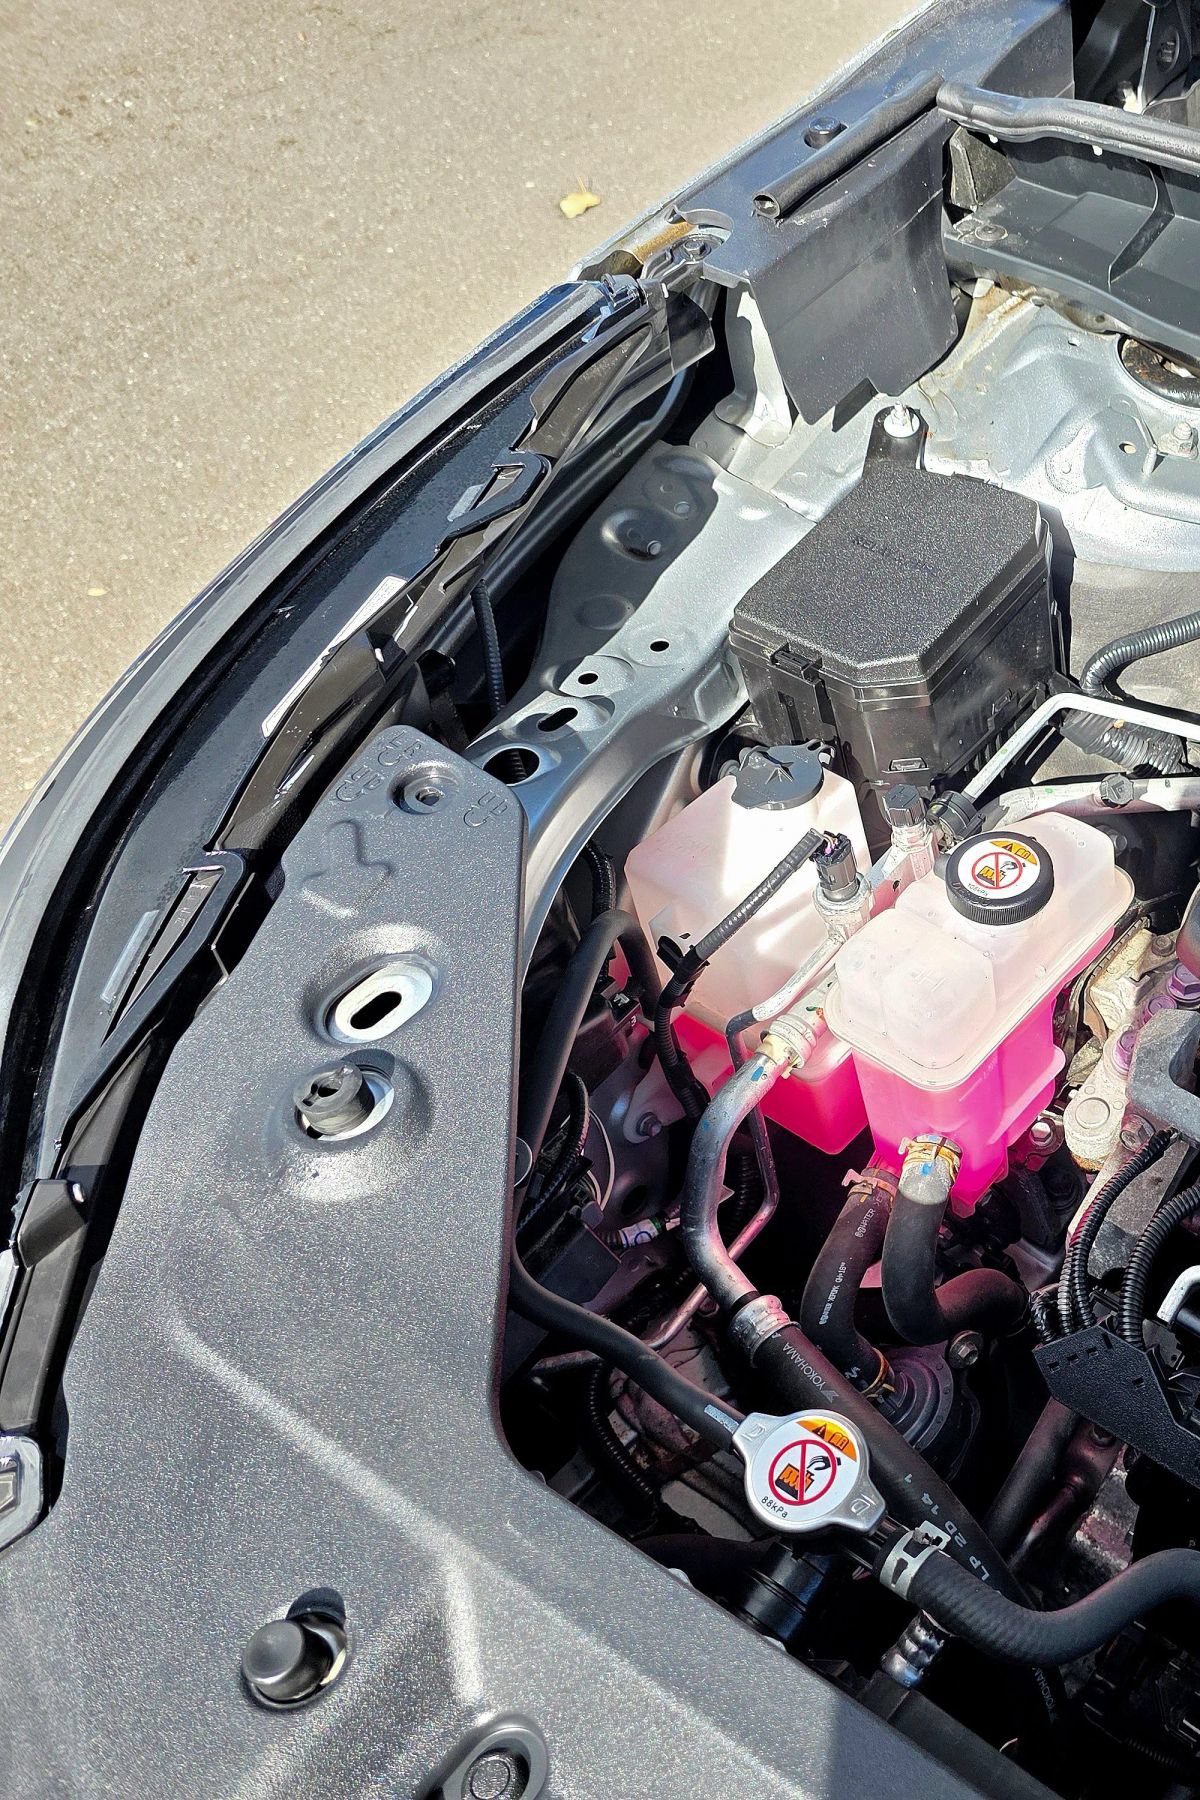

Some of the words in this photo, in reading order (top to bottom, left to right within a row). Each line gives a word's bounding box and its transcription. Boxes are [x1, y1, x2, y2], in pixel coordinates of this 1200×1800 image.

[782, 1342, 827, 1391] YOKOHAMA
[760, 1495, 789, 1519] 88kPa
[921, 1492, 940, 1516] 14
[944, 1520, 968, 1549] 2D
[969, 1555, 990, 1581] LP
